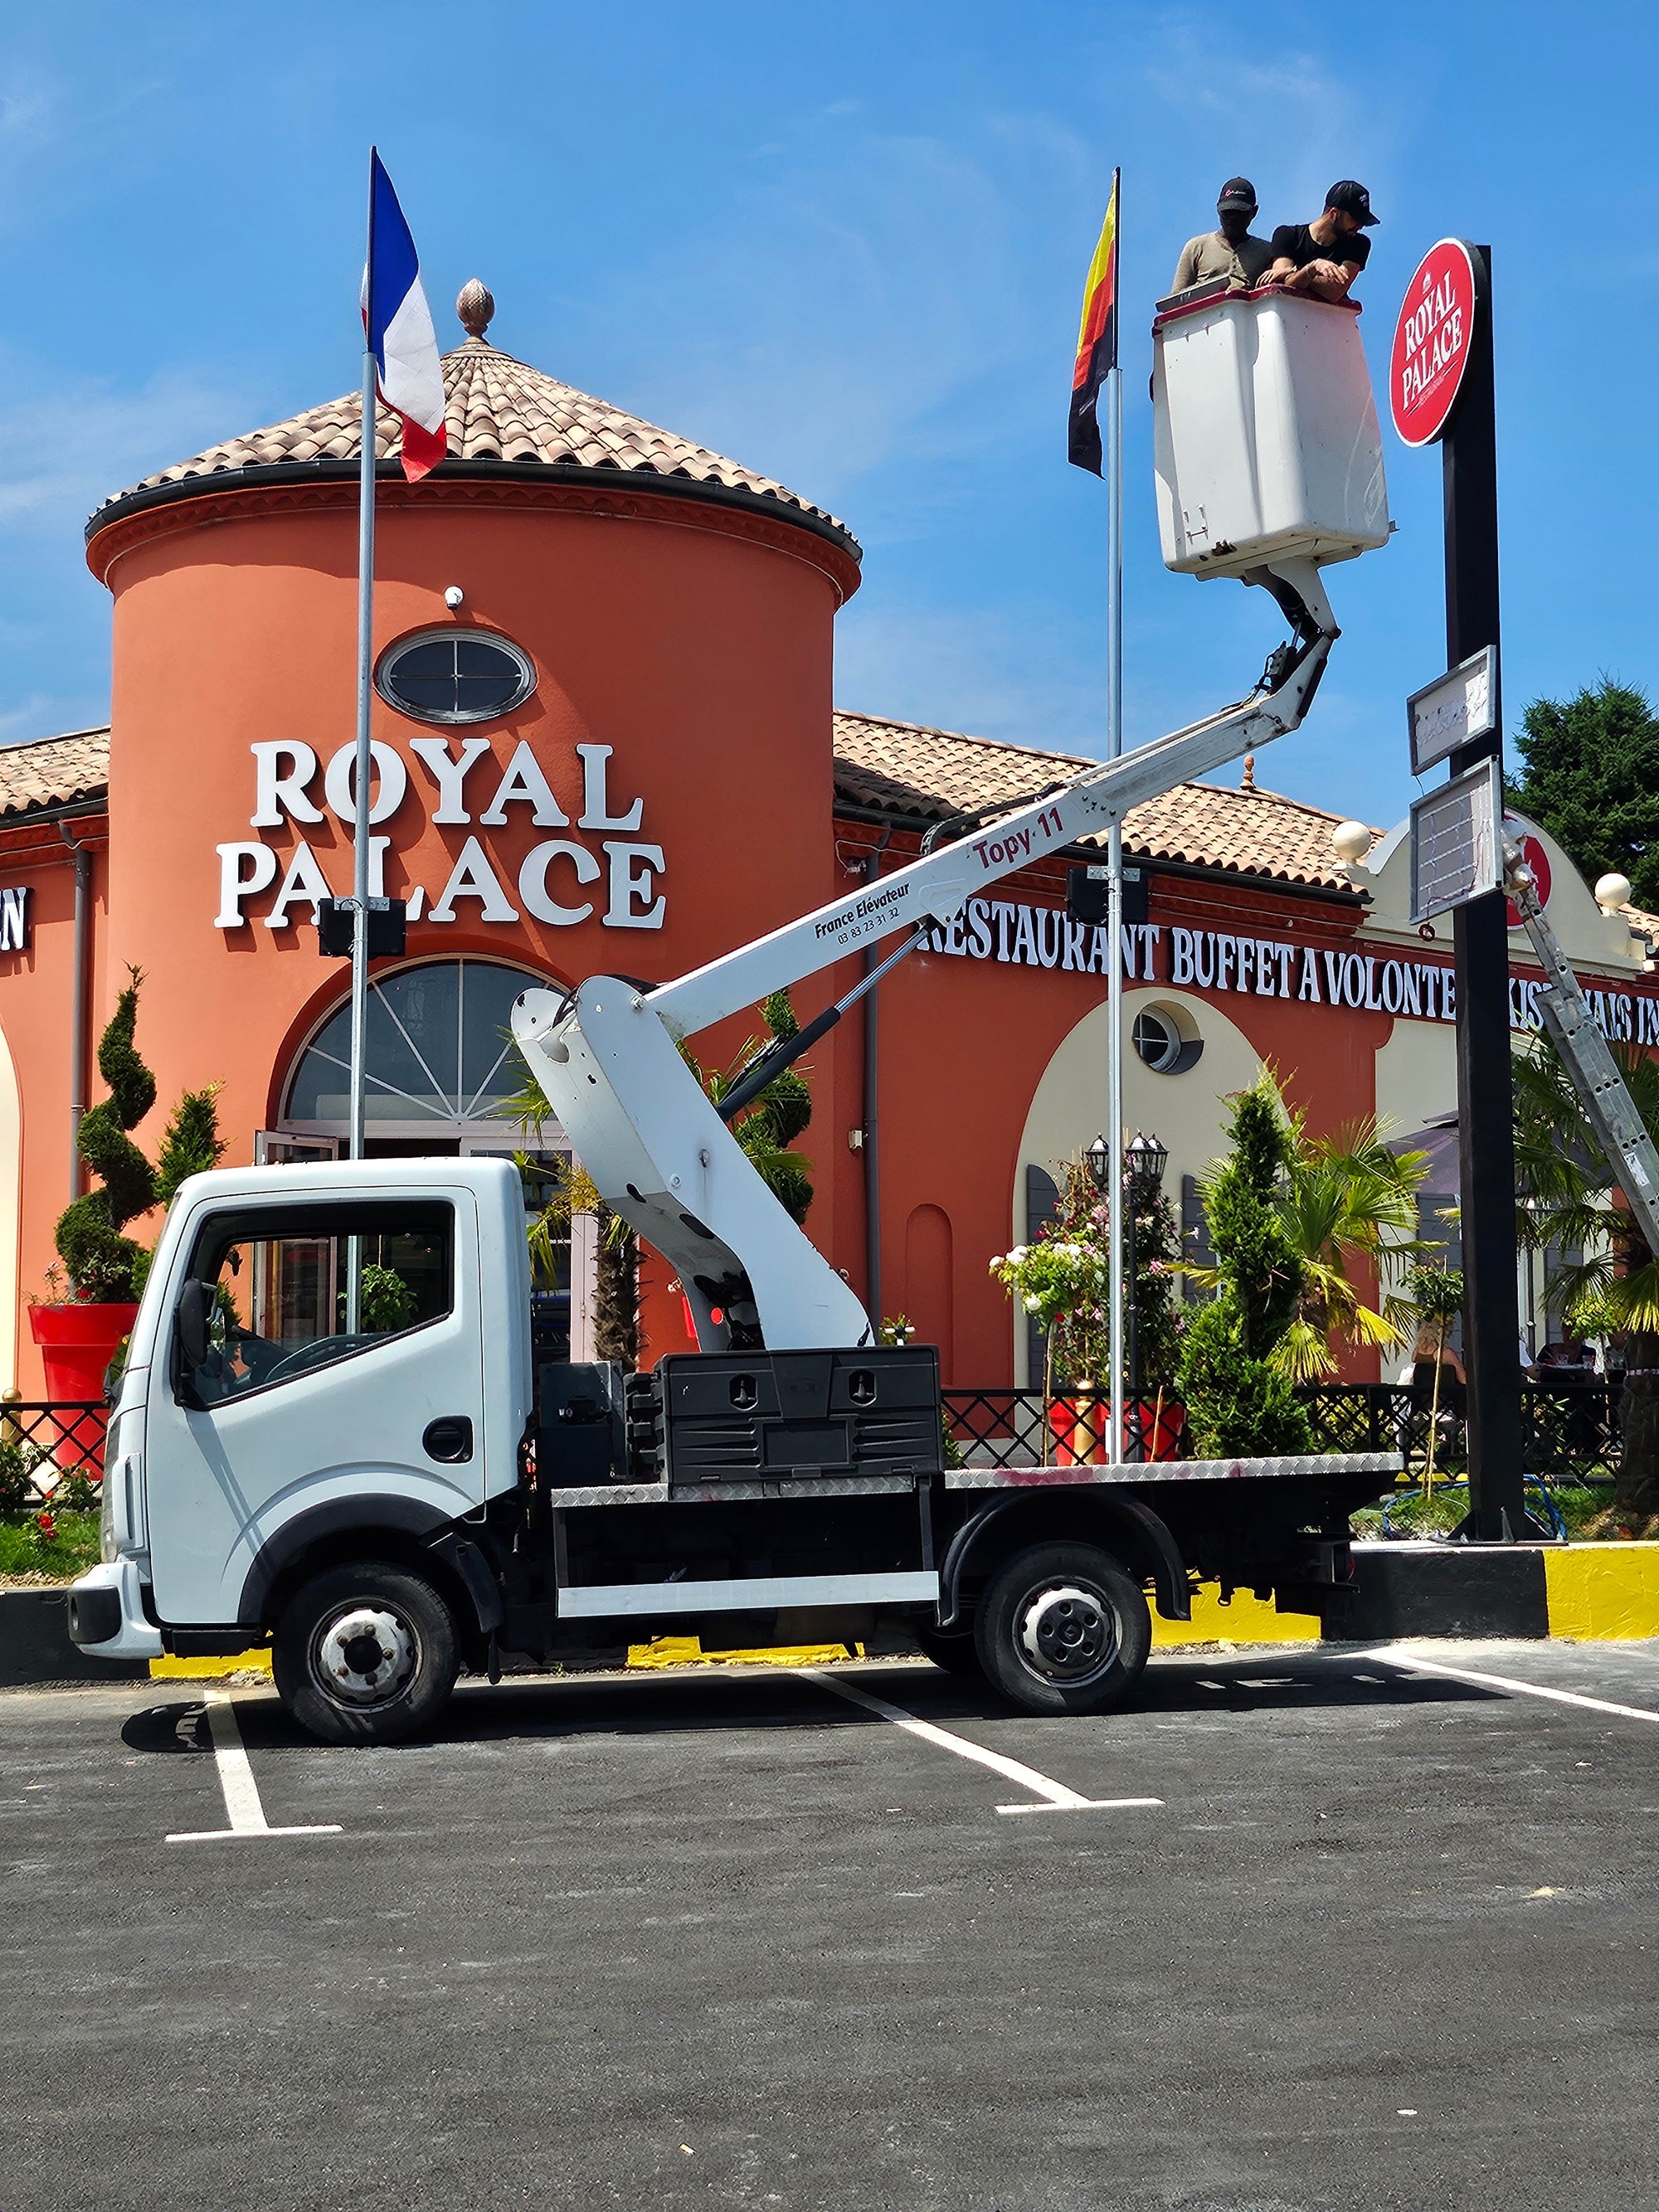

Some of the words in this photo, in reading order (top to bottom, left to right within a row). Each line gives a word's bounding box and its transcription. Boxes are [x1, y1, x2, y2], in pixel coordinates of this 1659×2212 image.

[1402, 308, 1462, 411] PALACE
[1404, 269, 1456, 361] ROYAL
[250, 737, 644, 832] ROYAL
[212, 835, 666, 930] PALACE
[972, 829, 1030, 868] Topy
[1037, 807, 1063, 837] 11
[0, 886, 27, 951] N
[814, 912, 855, 940] France
[855, 882, 910, 919] Elévateur
[838, 932, 849, 945] 03
[850, 926, 862, 938] 83
[863, 920, 874, 932] 23
[876, 914, 887, 926] 31
[888, 907, 899, 920] 32
[1172, 926, 1294, 999] BUFFET
[1298, 947, 1321, 1003] A
[1324, 950, 1457, 1021] VOLONTE
